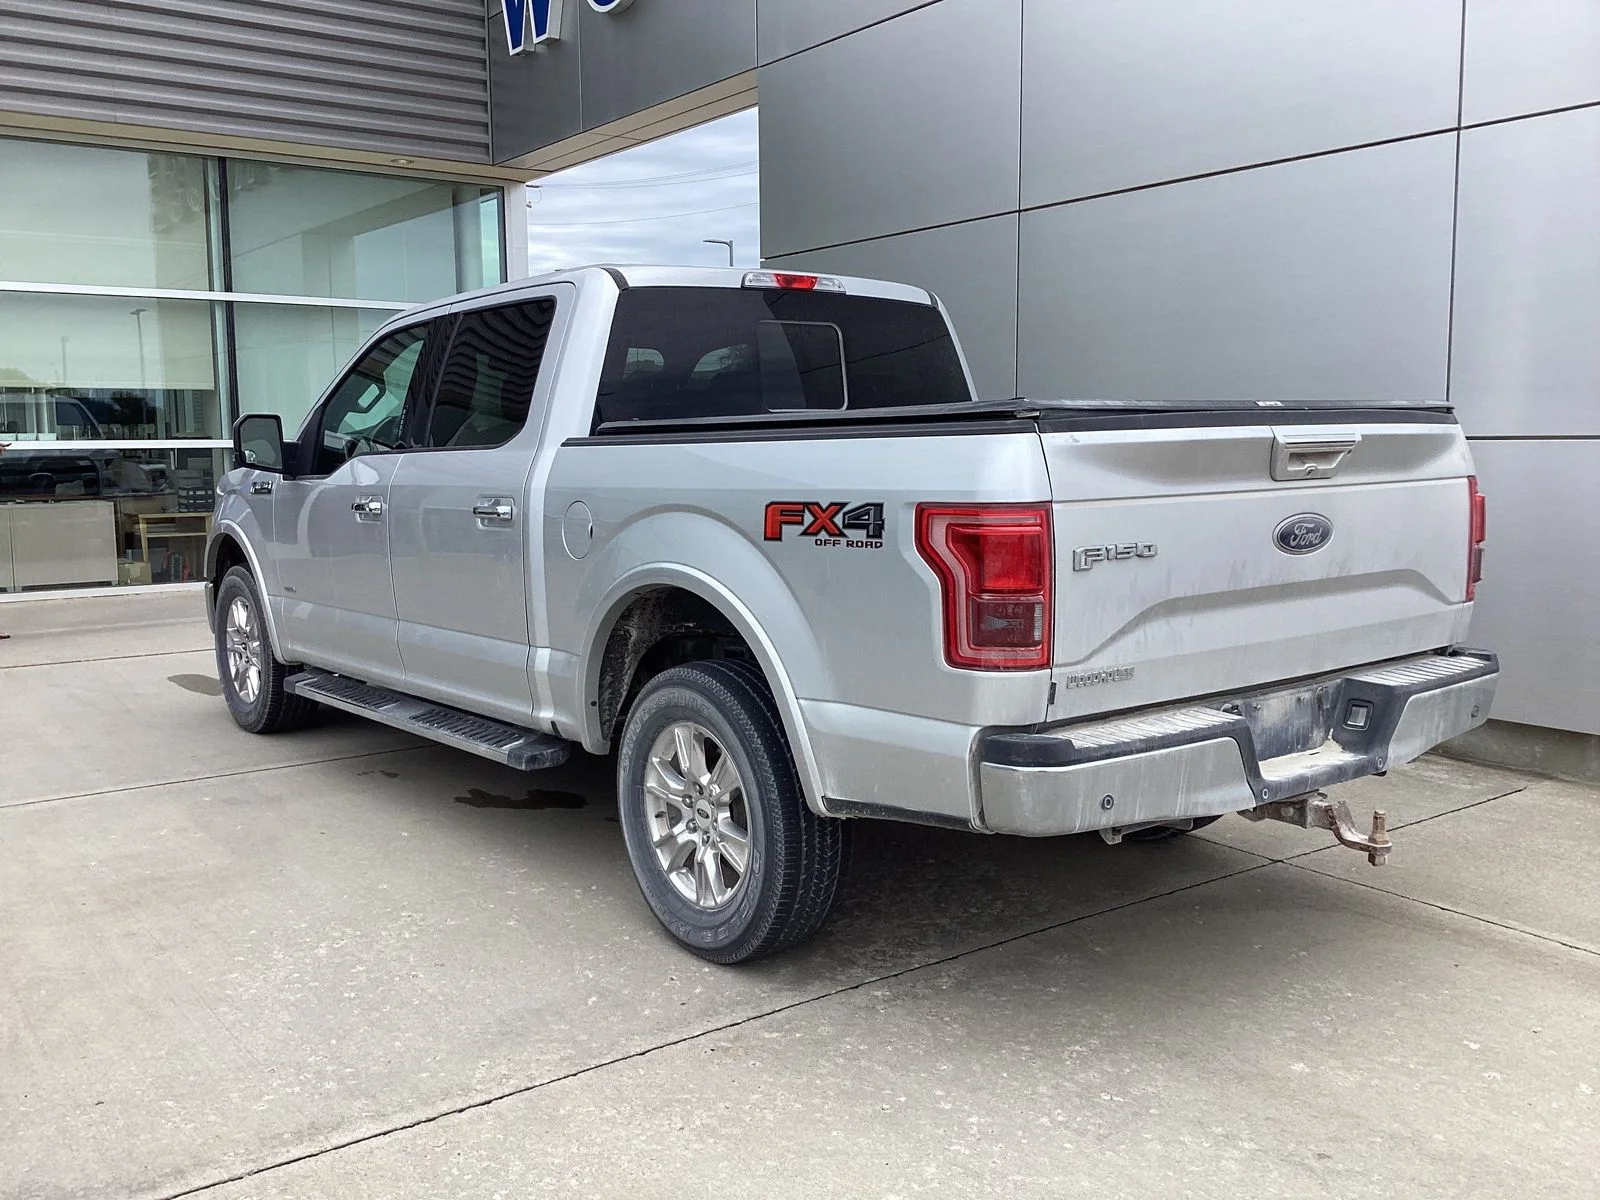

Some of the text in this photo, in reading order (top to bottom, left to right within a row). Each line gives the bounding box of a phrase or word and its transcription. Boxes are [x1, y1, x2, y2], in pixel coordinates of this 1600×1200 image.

[764, 501, 885, 541] FX4
[814, 538, 884, 549] OFF ROAD
[1290, 522, 1323, 546] Ford
[1066, 666, 1136, 689] WOODHOUSE
